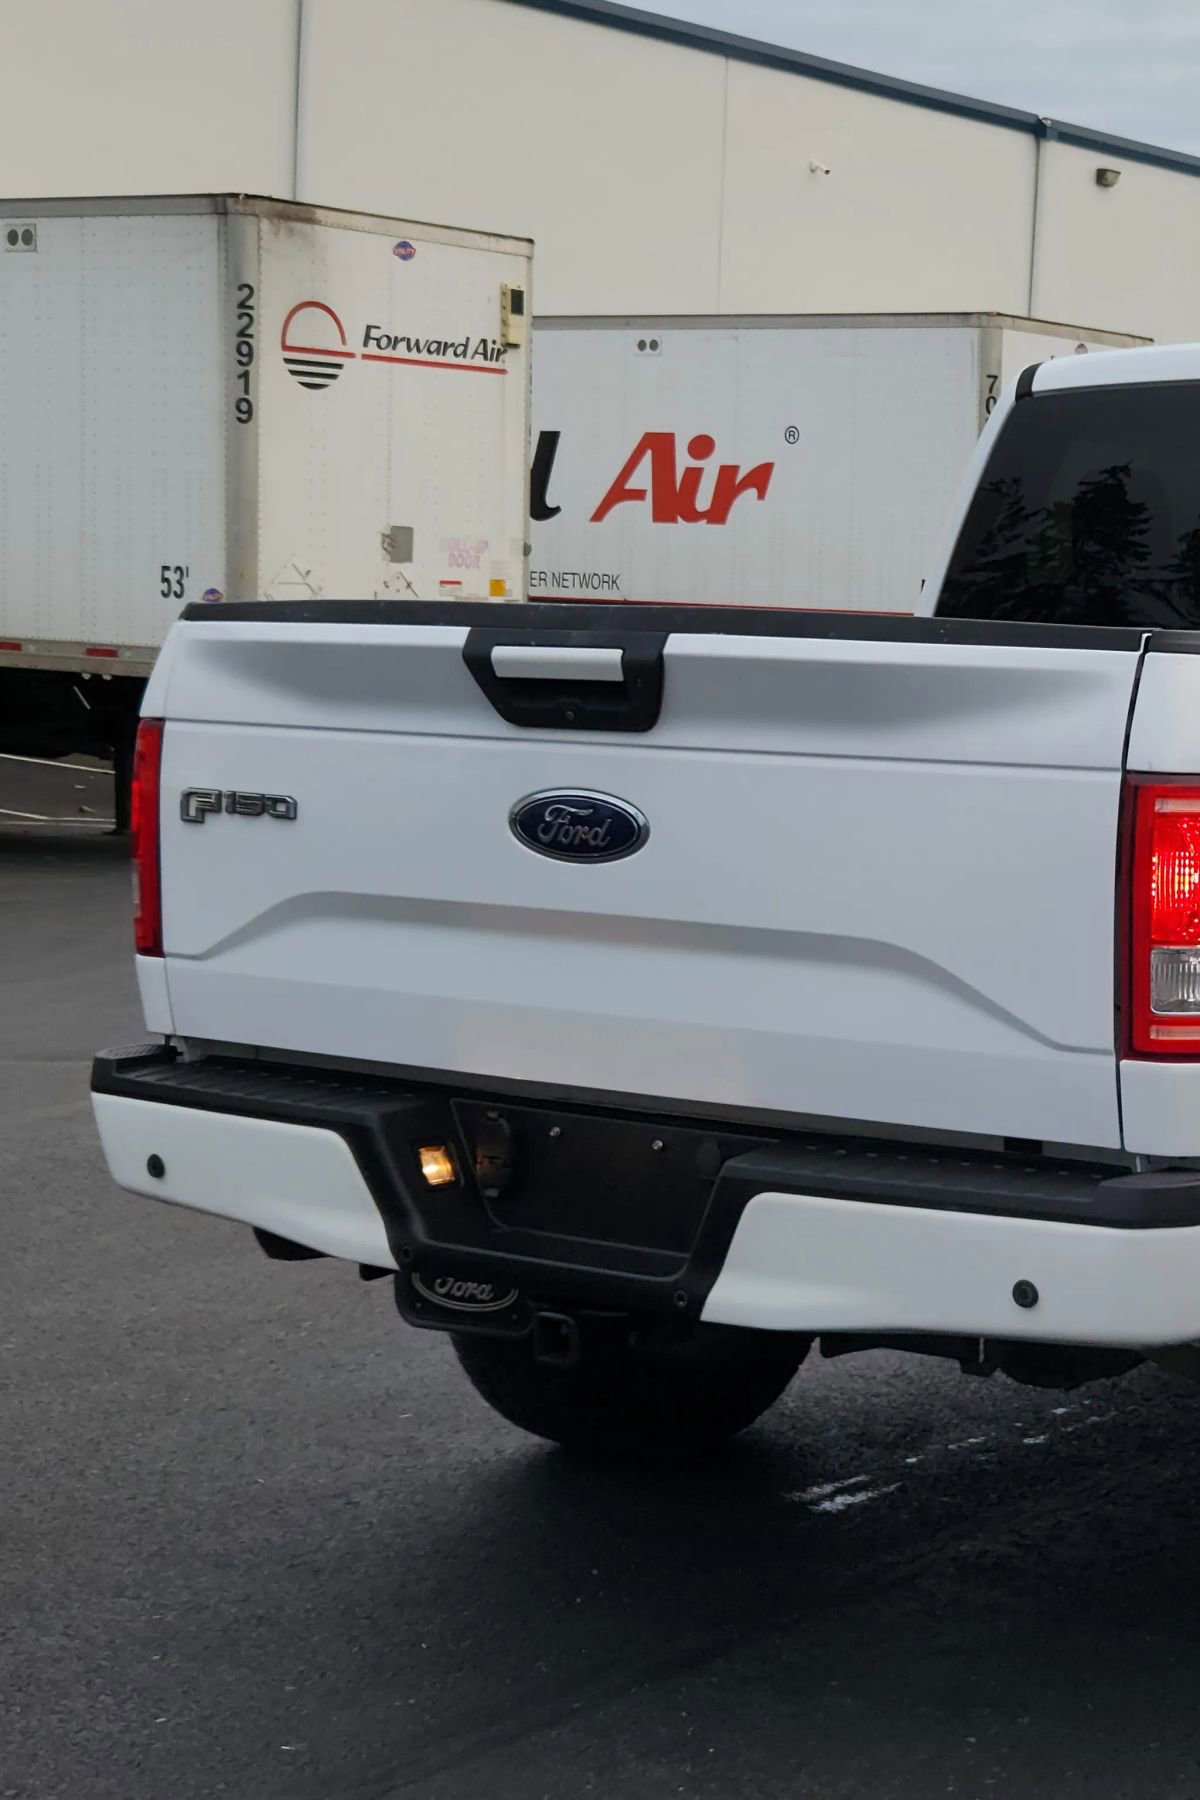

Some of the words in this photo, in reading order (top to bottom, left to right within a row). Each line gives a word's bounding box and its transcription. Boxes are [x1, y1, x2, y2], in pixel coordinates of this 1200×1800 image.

[235, 283, 255, 424] 22919
[362, 324, 470, 359] Forward
[471, 338, 508, 363] Air
[589, 431, 775, 525] Air
[551, 572, 620, 591] NETWORK
[537, 804, 613, 847] Ford
